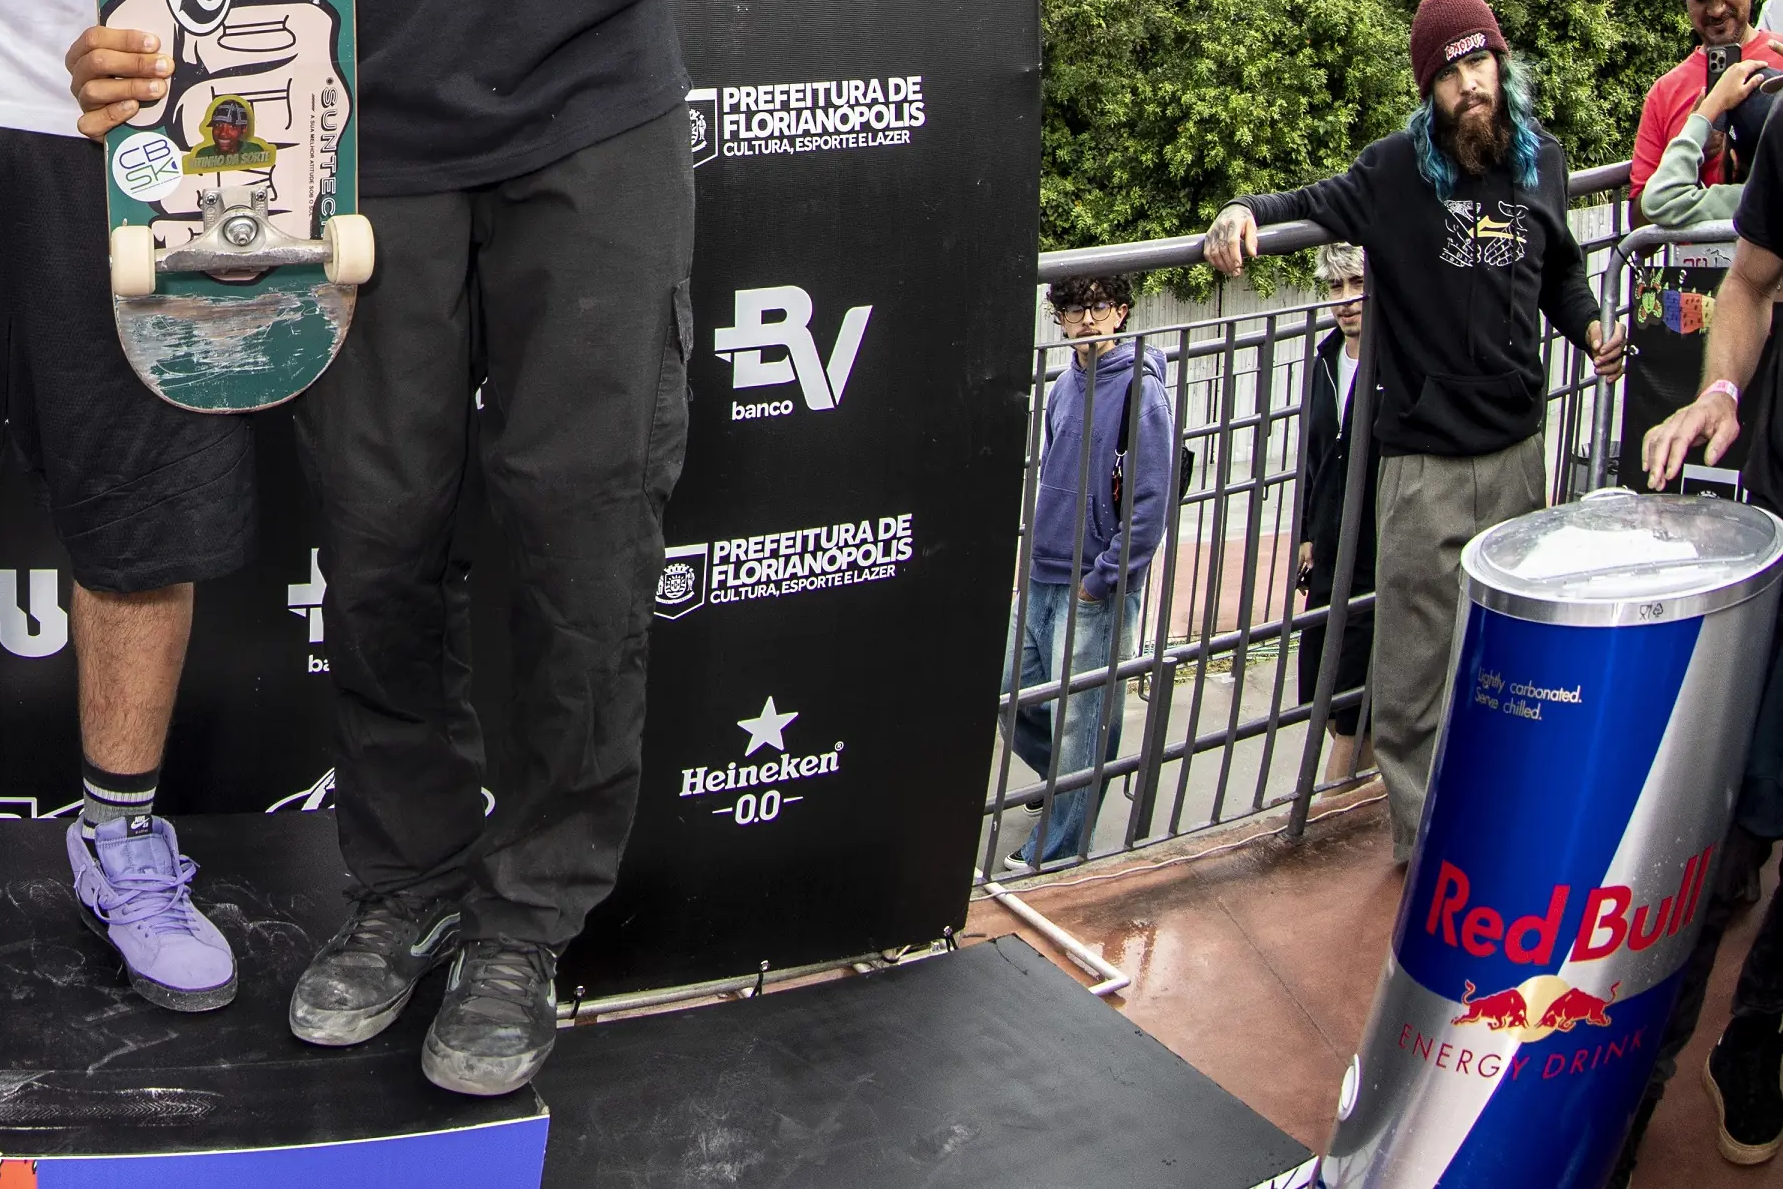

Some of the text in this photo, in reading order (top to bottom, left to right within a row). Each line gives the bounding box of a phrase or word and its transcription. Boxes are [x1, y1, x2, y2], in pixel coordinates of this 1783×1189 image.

[722, 76, 923, 113] PREFEITURA DE
[722, 101, 925, 139] FLORIANÓPOLIS
[240, 150, 270, 165] SORTE
[320, 87, 338, 238] SUNTEC
[723, 130, 911, 157] CULTURA, ESPORTE E LAZER
[731, 399, 793, 420] banco
[712, 513, 913, 564] PREFEITURA DE
[711, 538, 913, 589] FLORIANÓPOLIS
[710, 565, 896, 604] CULTURA, ESPORTE E LAZER
[1475, 687, 1542, 721] Serve chilled.
[1478, 667, 1582, 703] Lightly carbonated.
[679, 751, 840, 797] Heineken
[1424, 845, 1718, 966] Red Bull
[1398, 1022, 1649, 1082] ENERGY DRINK
